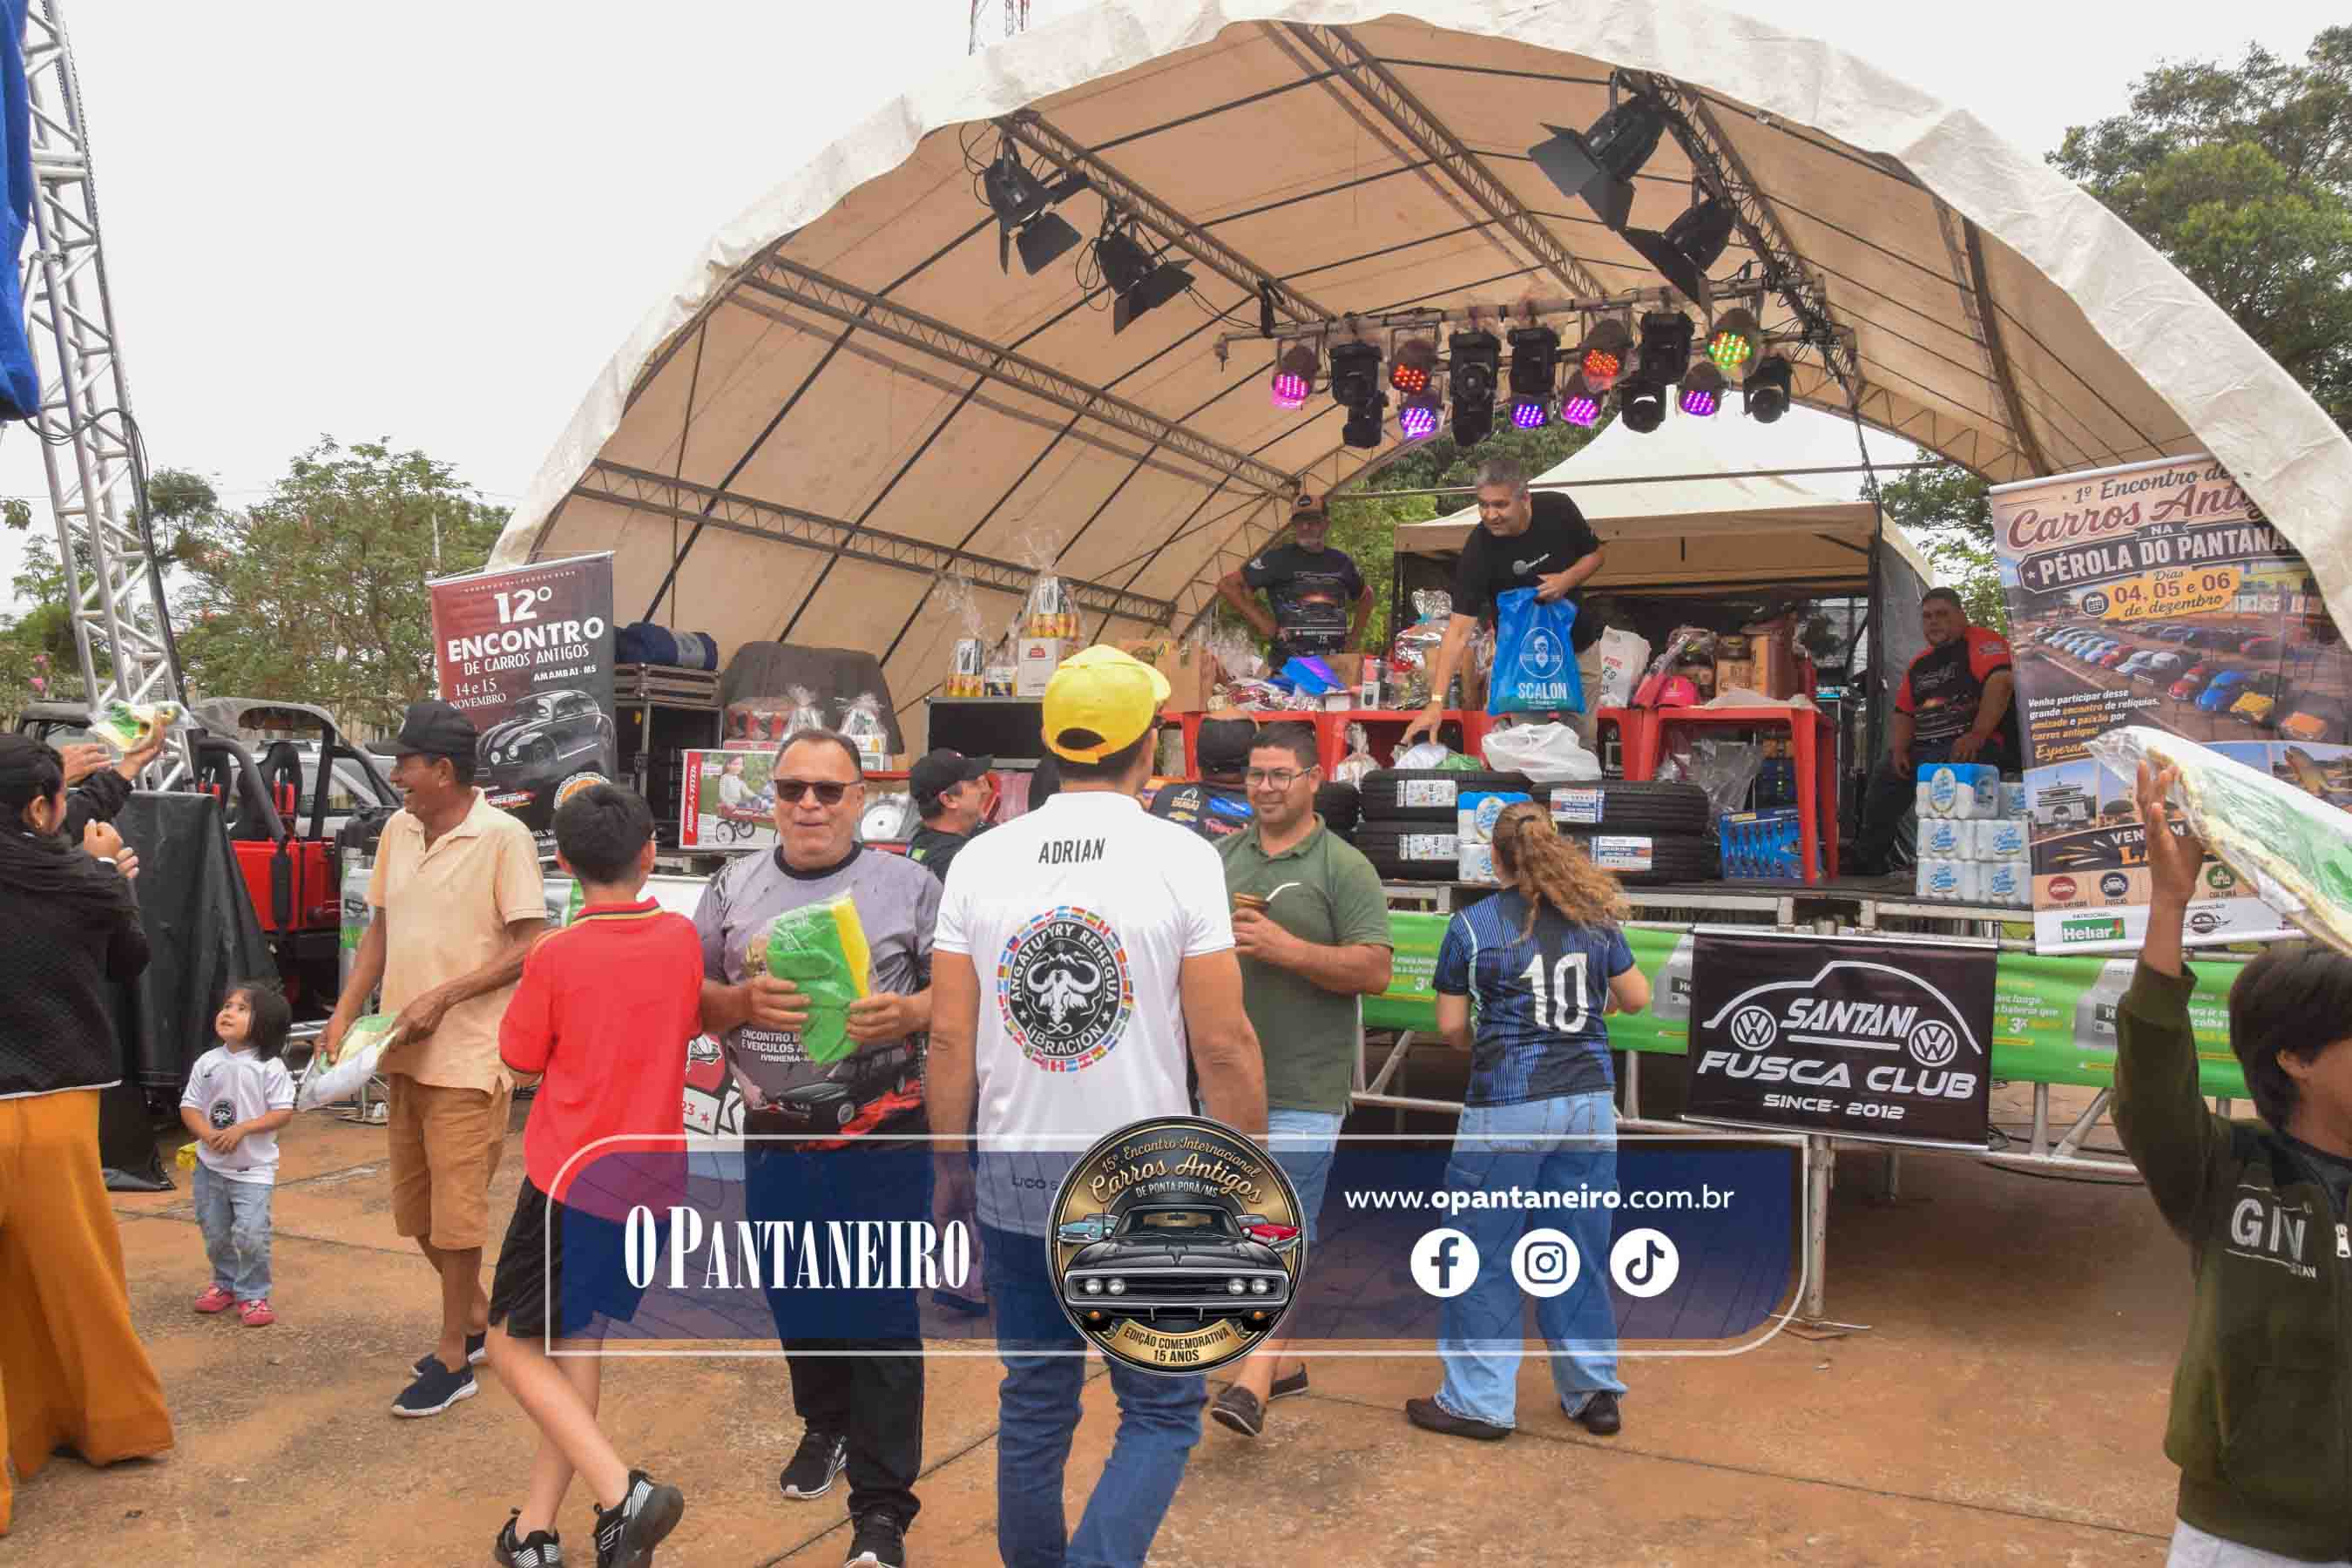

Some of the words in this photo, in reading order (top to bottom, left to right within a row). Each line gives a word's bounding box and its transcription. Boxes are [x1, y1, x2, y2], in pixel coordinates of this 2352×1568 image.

[2100, 470, 2199, 501] Encontro
[2007, 501, 2140, 549] Carros
[2151, 525, 2173, 537] NA
[2040, 544, 2133, 585] PÉROLA
[2139, 537, 2173, 566] DO
[2178, 527, 2298, 560] PANTANA
[2153, 570, 2184, 582] Dias
[2153, 581, 2180, 599] 05
[2186, 584, 2196, 593] e
[2202, 571, 2231, 591] 06
[2125, 604, 2143, 617] de
[2148, 594, 2224, 615] dezembro
[447, 616, 605, 663] ENCONTRO
[464, 662, 480, 676] DE
[484, 652, 531, 672] CARROS
[536, 643, 590, 665] ANTIGOS
[533, 668, 579, 682] AMAMBAI
[584, 664, 597, 675] MS
[455, 680, 470, 695] 14
[472, 683, 480, 694] e
[483, 678, 497, 693] 15
[1518, 682, 1567, 700] SCALON
[2028, 697, 2056, 707] Venha
[2057, 692, 2102, 706] participar
[2103, 689, 2129, 699] desse
[2029, 707, 2061, 720] grande
[2105, 700, 2117, 710] de
[2109, 712, 2126, 723] por
[1037, 837, 1105, 864] ADRIAN
[1078, 928, 1119, 1004] REHEGUA
[1519, 953, 1590, 1033] 10
[1780, 997, 1918, 1038] SANTANI
[741, 1029, 791, 1043] ENCONTRO
[1696, 1051, 1851, 1089] FUSCA
[1865, 1066, 1978, 1100] CLUB
[1845, 1101, 1906, 1120] 2012
